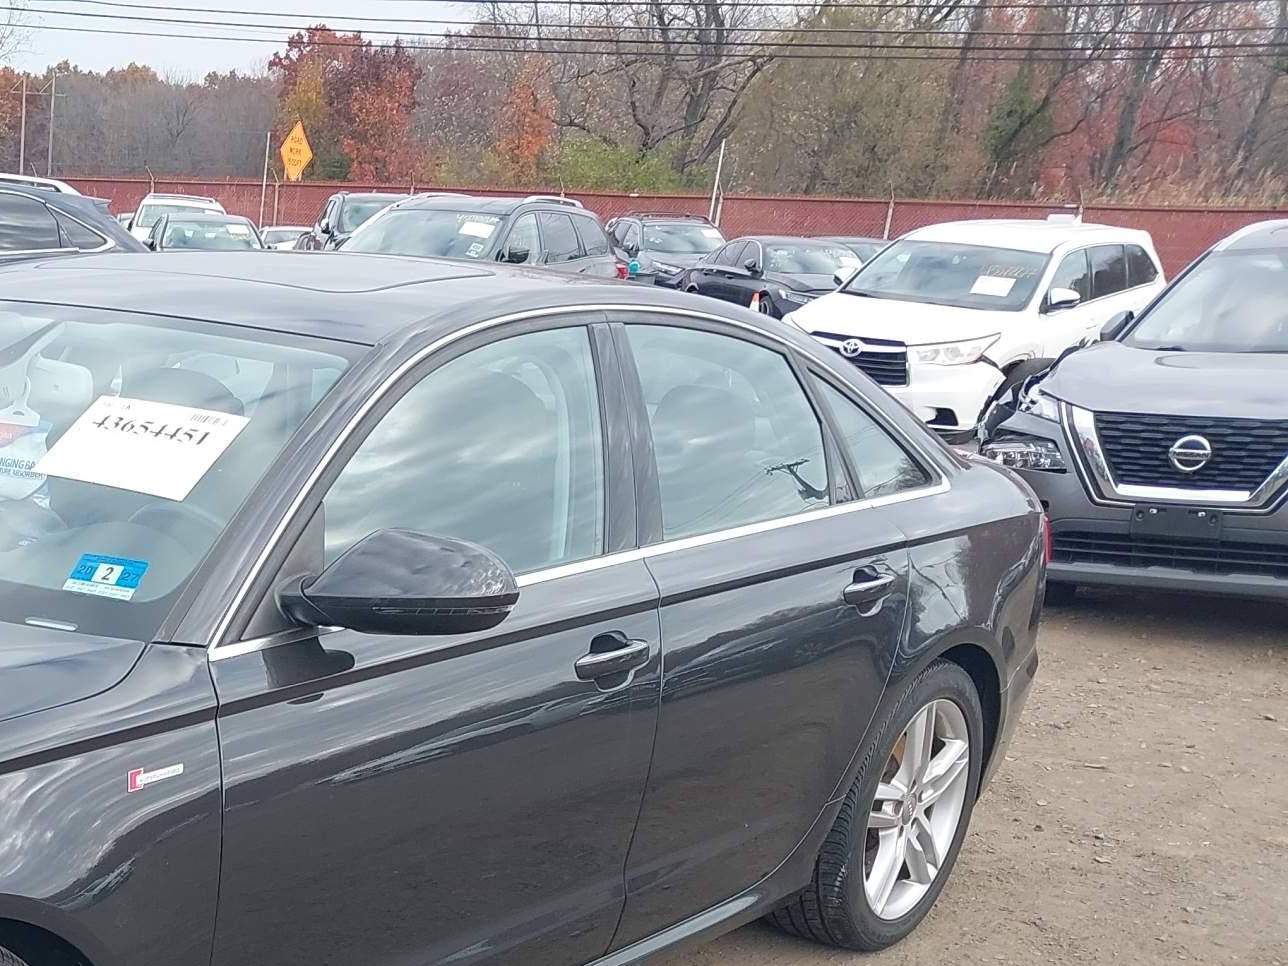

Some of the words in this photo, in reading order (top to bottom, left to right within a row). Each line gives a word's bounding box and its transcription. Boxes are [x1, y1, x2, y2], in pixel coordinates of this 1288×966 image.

[92, 414, 211, 446] 43654451
[100, 566, 115, 581] 2
[120, 571, 139, 582] 27
